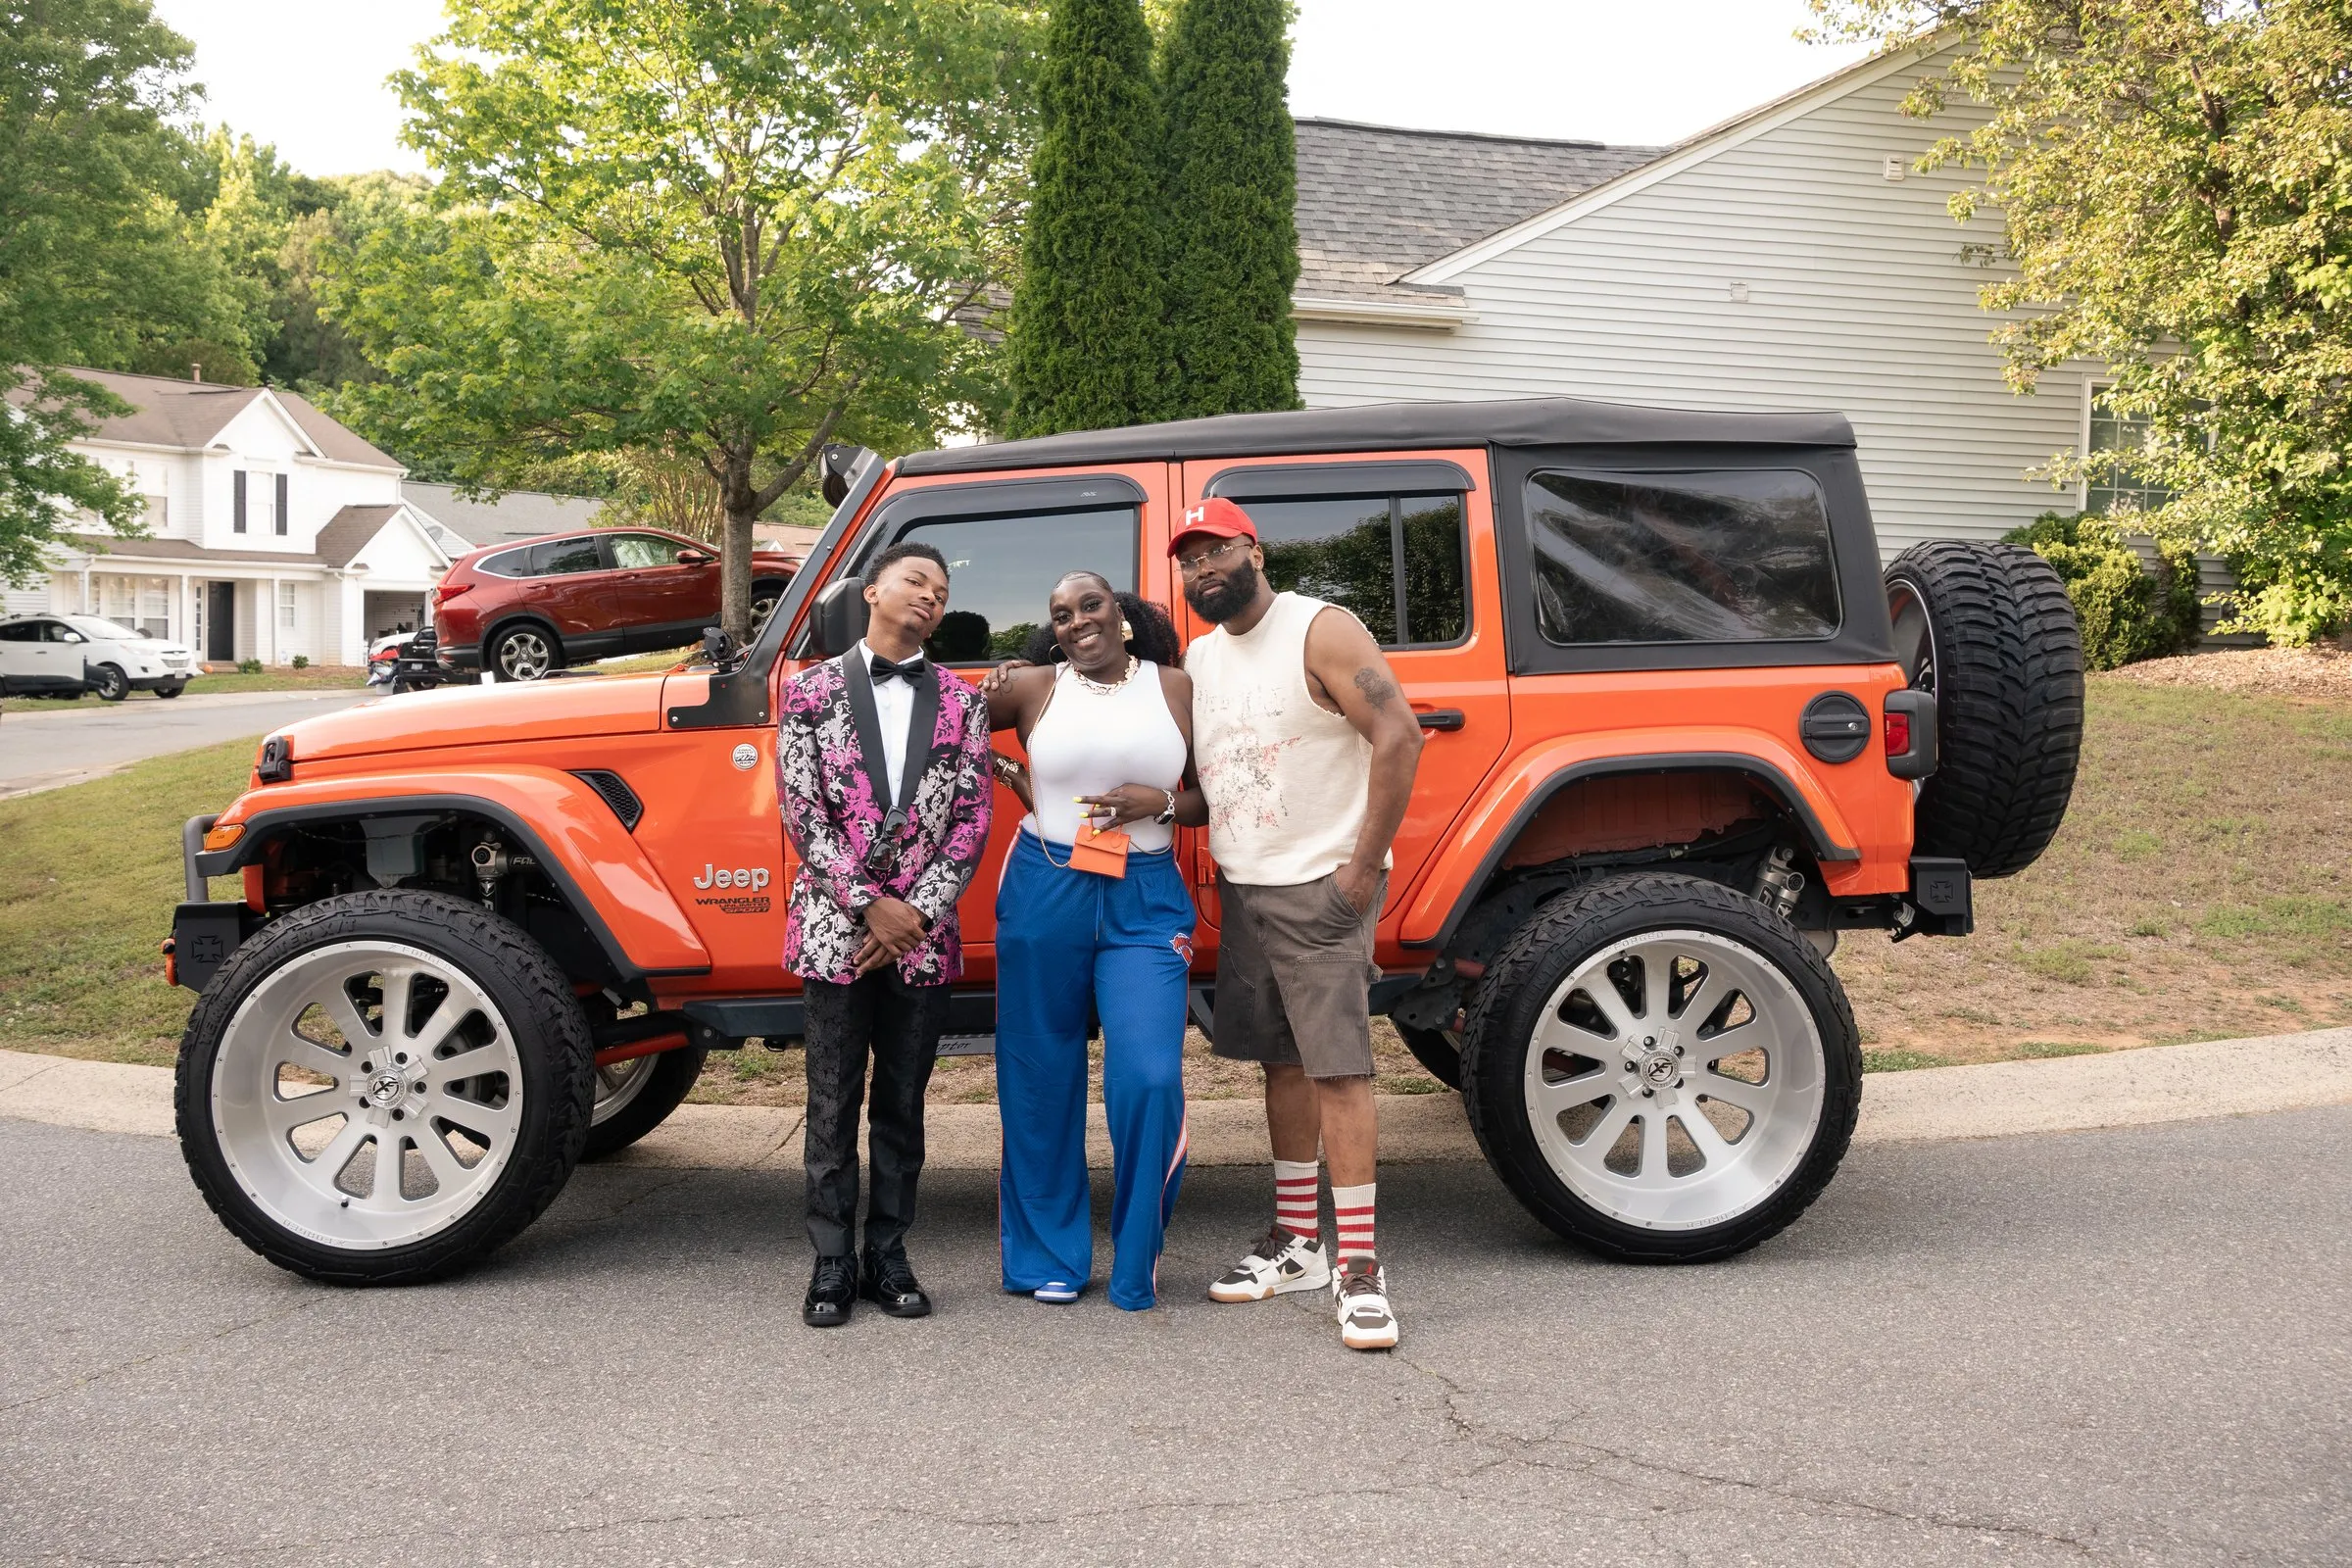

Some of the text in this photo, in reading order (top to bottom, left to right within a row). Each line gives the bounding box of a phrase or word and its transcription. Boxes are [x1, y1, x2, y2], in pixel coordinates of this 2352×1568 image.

[1185, 506, 1204, 526] H
[513, 856, 536, 865] FAL
[693, 863, 770, 893] Jeep
[695, 896, 770, 905] WRANGLER
[198, 918, 357, 1045] TERRA HUNTER X/T
[936, 1041, 972, 1054] ptor
